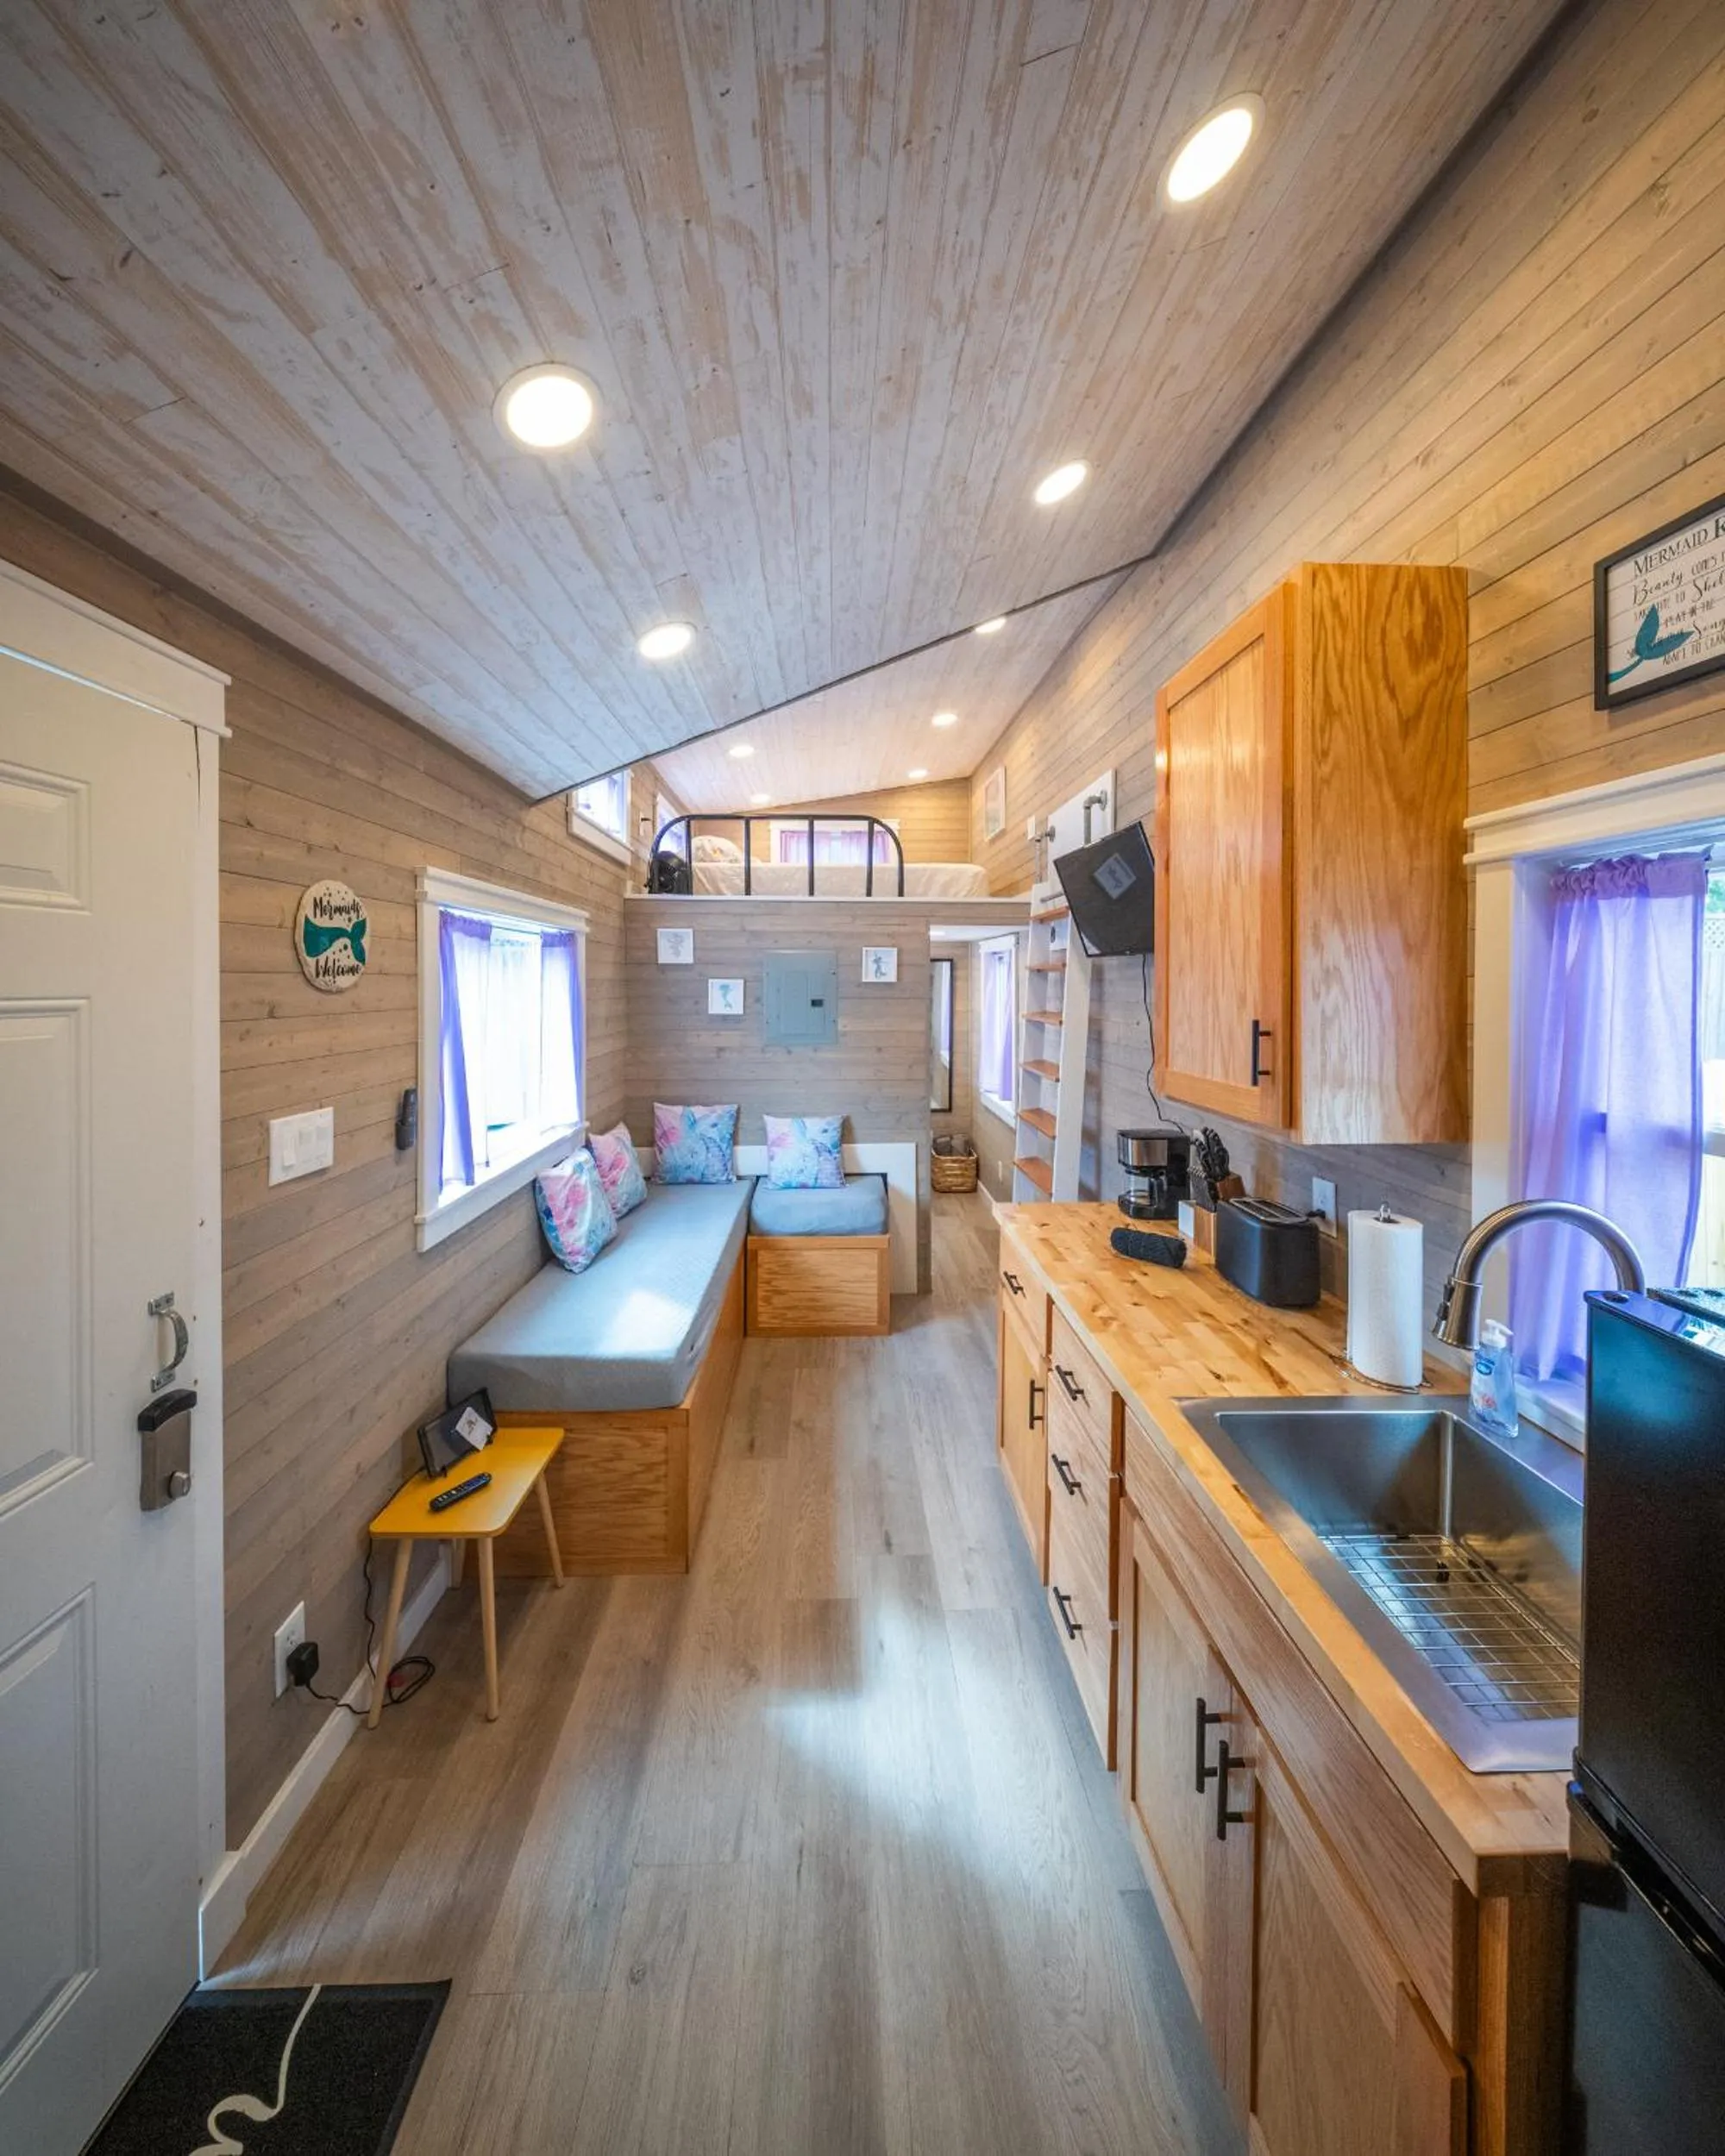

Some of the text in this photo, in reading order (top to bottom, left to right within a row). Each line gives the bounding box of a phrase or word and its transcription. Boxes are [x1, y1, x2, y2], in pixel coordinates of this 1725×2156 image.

[1634, 528, 1708, 579] MERMAID
[1633, 571, 1683, 606] Beauty
[316, 956, 361, 979] Welcome
